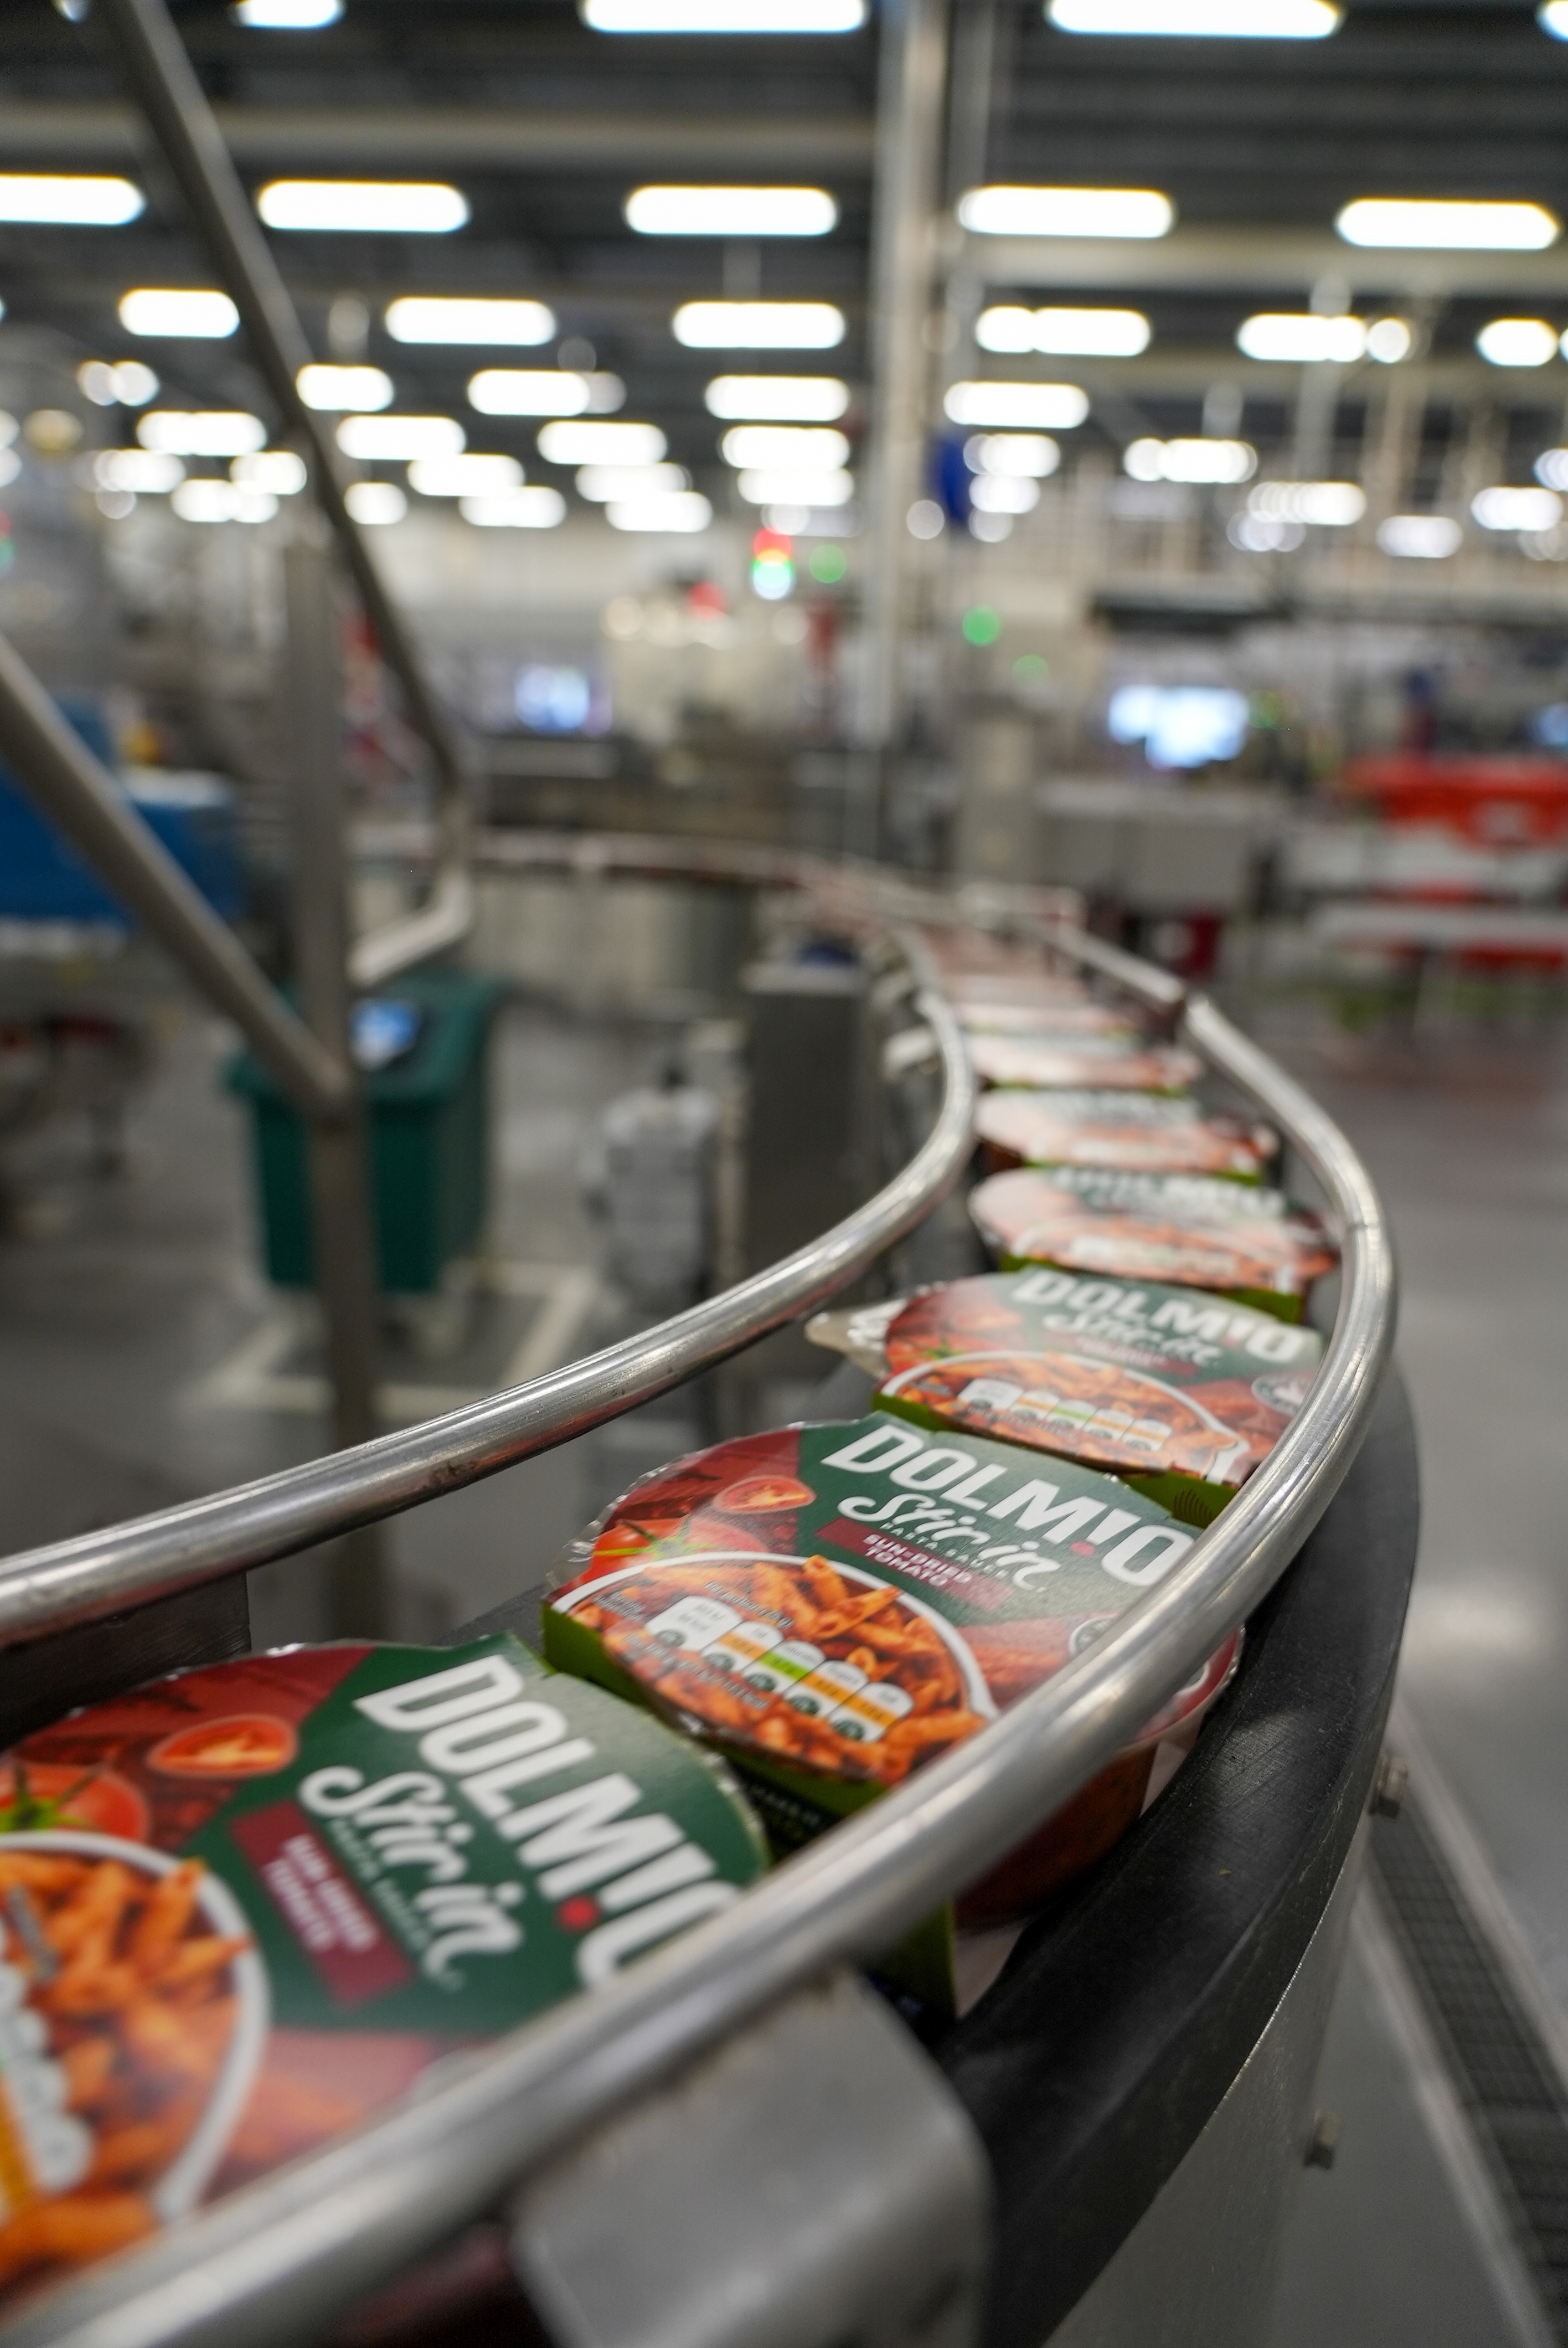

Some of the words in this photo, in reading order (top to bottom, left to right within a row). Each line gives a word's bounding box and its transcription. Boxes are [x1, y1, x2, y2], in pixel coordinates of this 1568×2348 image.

[879, 1522, 939, 1551] PASTA
[863, 1533, 973, 1584] SUN-DRIED
[864, 1545, 949, 1587] TOMATO
